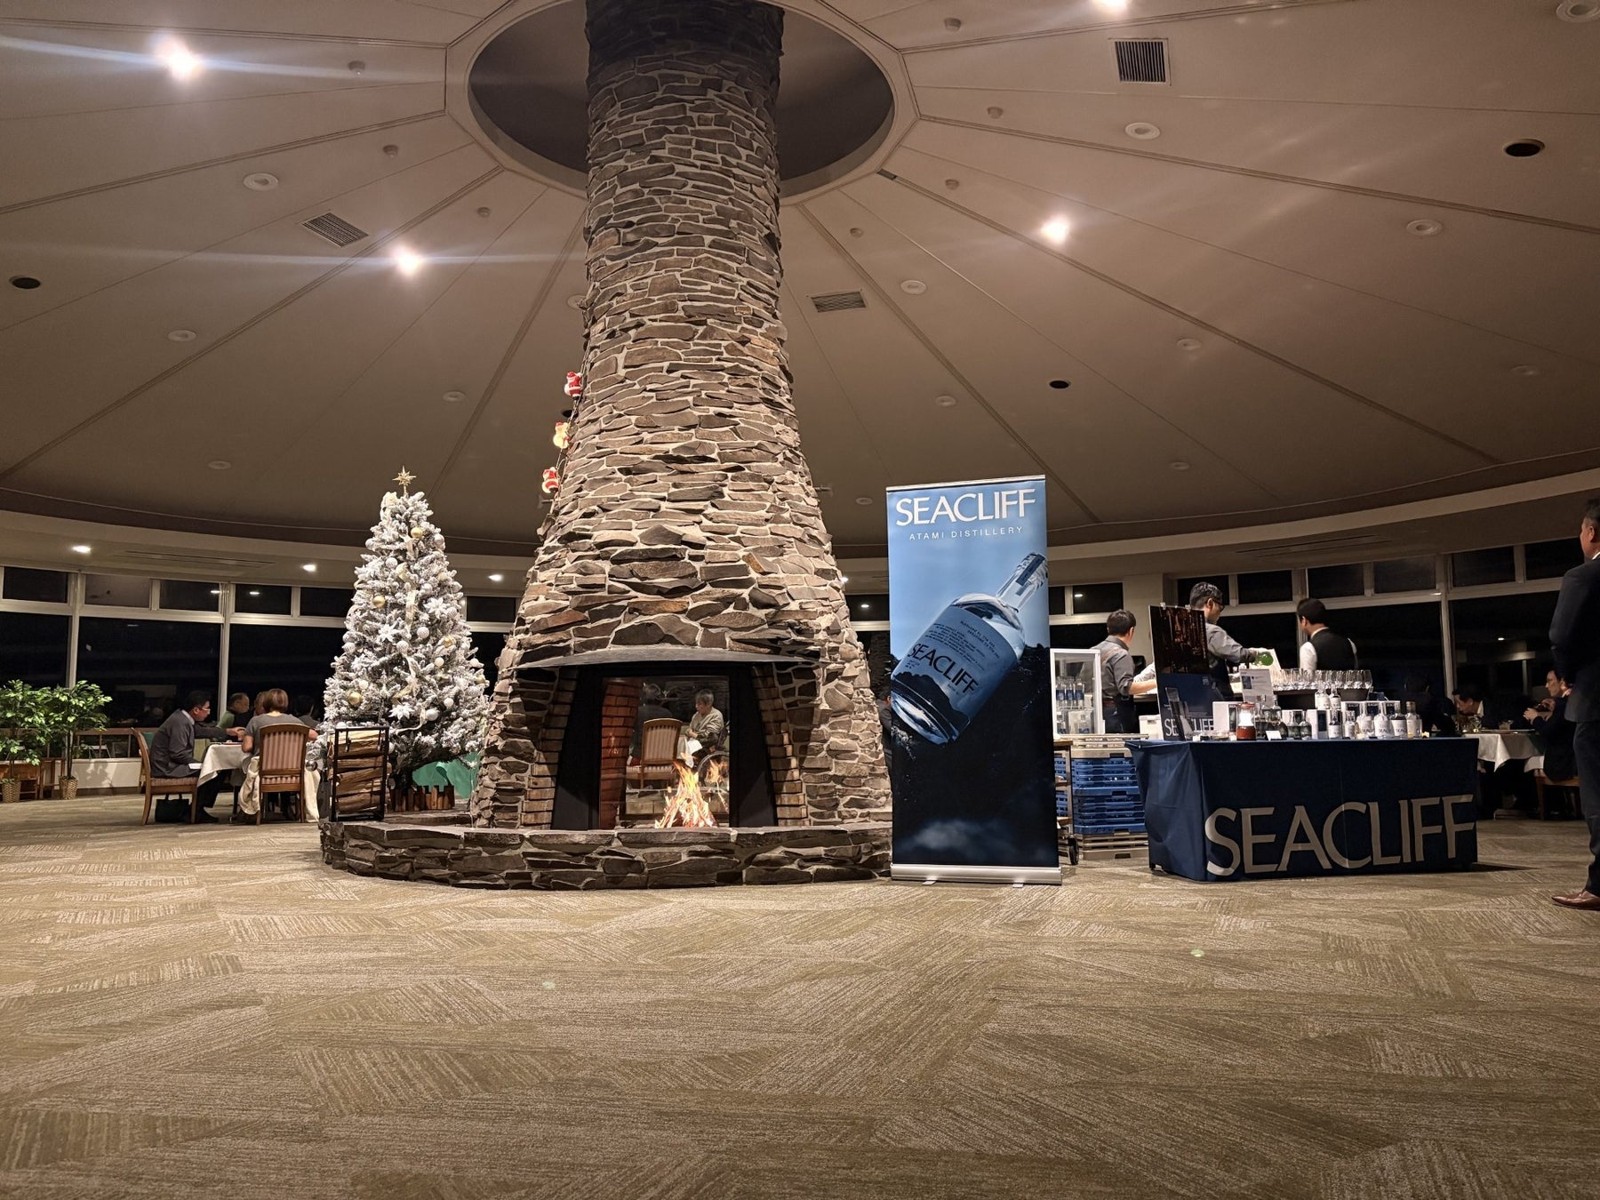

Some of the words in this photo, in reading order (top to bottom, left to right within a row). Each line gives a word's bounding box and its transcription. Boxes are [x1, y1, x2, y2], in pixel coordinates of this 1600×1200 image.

[895, 488, 1036, 526] SEACLIFF
[909, 531, 945, 541] ATAMI
[951, 526, 1024, 538] DISTILLERY
[907, 643, 979, 693] SEACLIFF
[1164, 718, 1214, 736] SELIFF
[1204, 794, 1474, 877] SEACLIFF
